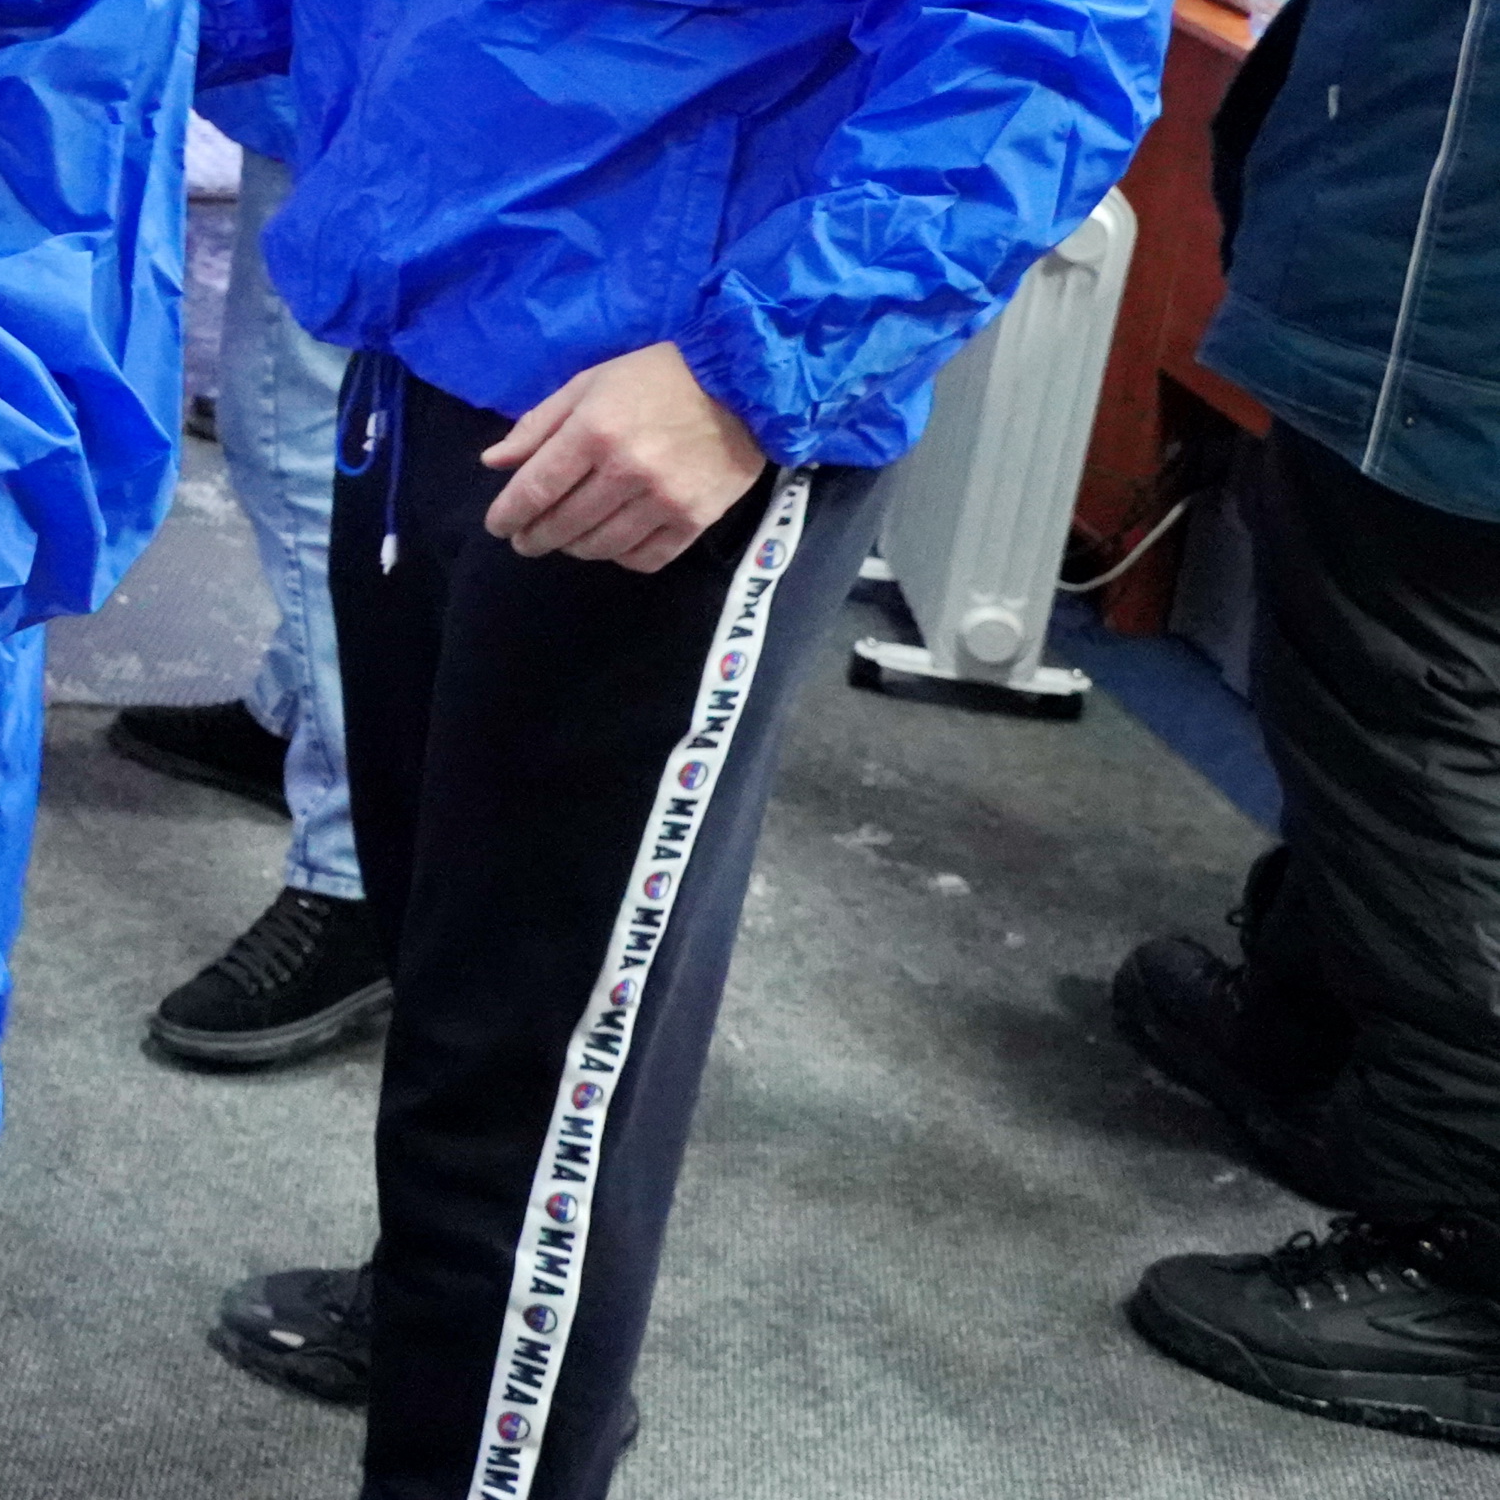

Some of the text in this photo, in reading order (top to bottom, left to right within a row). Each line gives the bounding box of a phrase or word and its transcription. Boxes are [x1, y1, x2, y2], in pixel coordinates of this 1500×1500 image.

[651, 798, 698, 861] MMA
[619, 907, 664, 970] MMA
[579, 1009, 626, 1074] MMA
[550, 1115, 594, 1183] MMA
[530, 1227, 575, 1297] MMA
[503, 1336, 551, 1407] MMA
